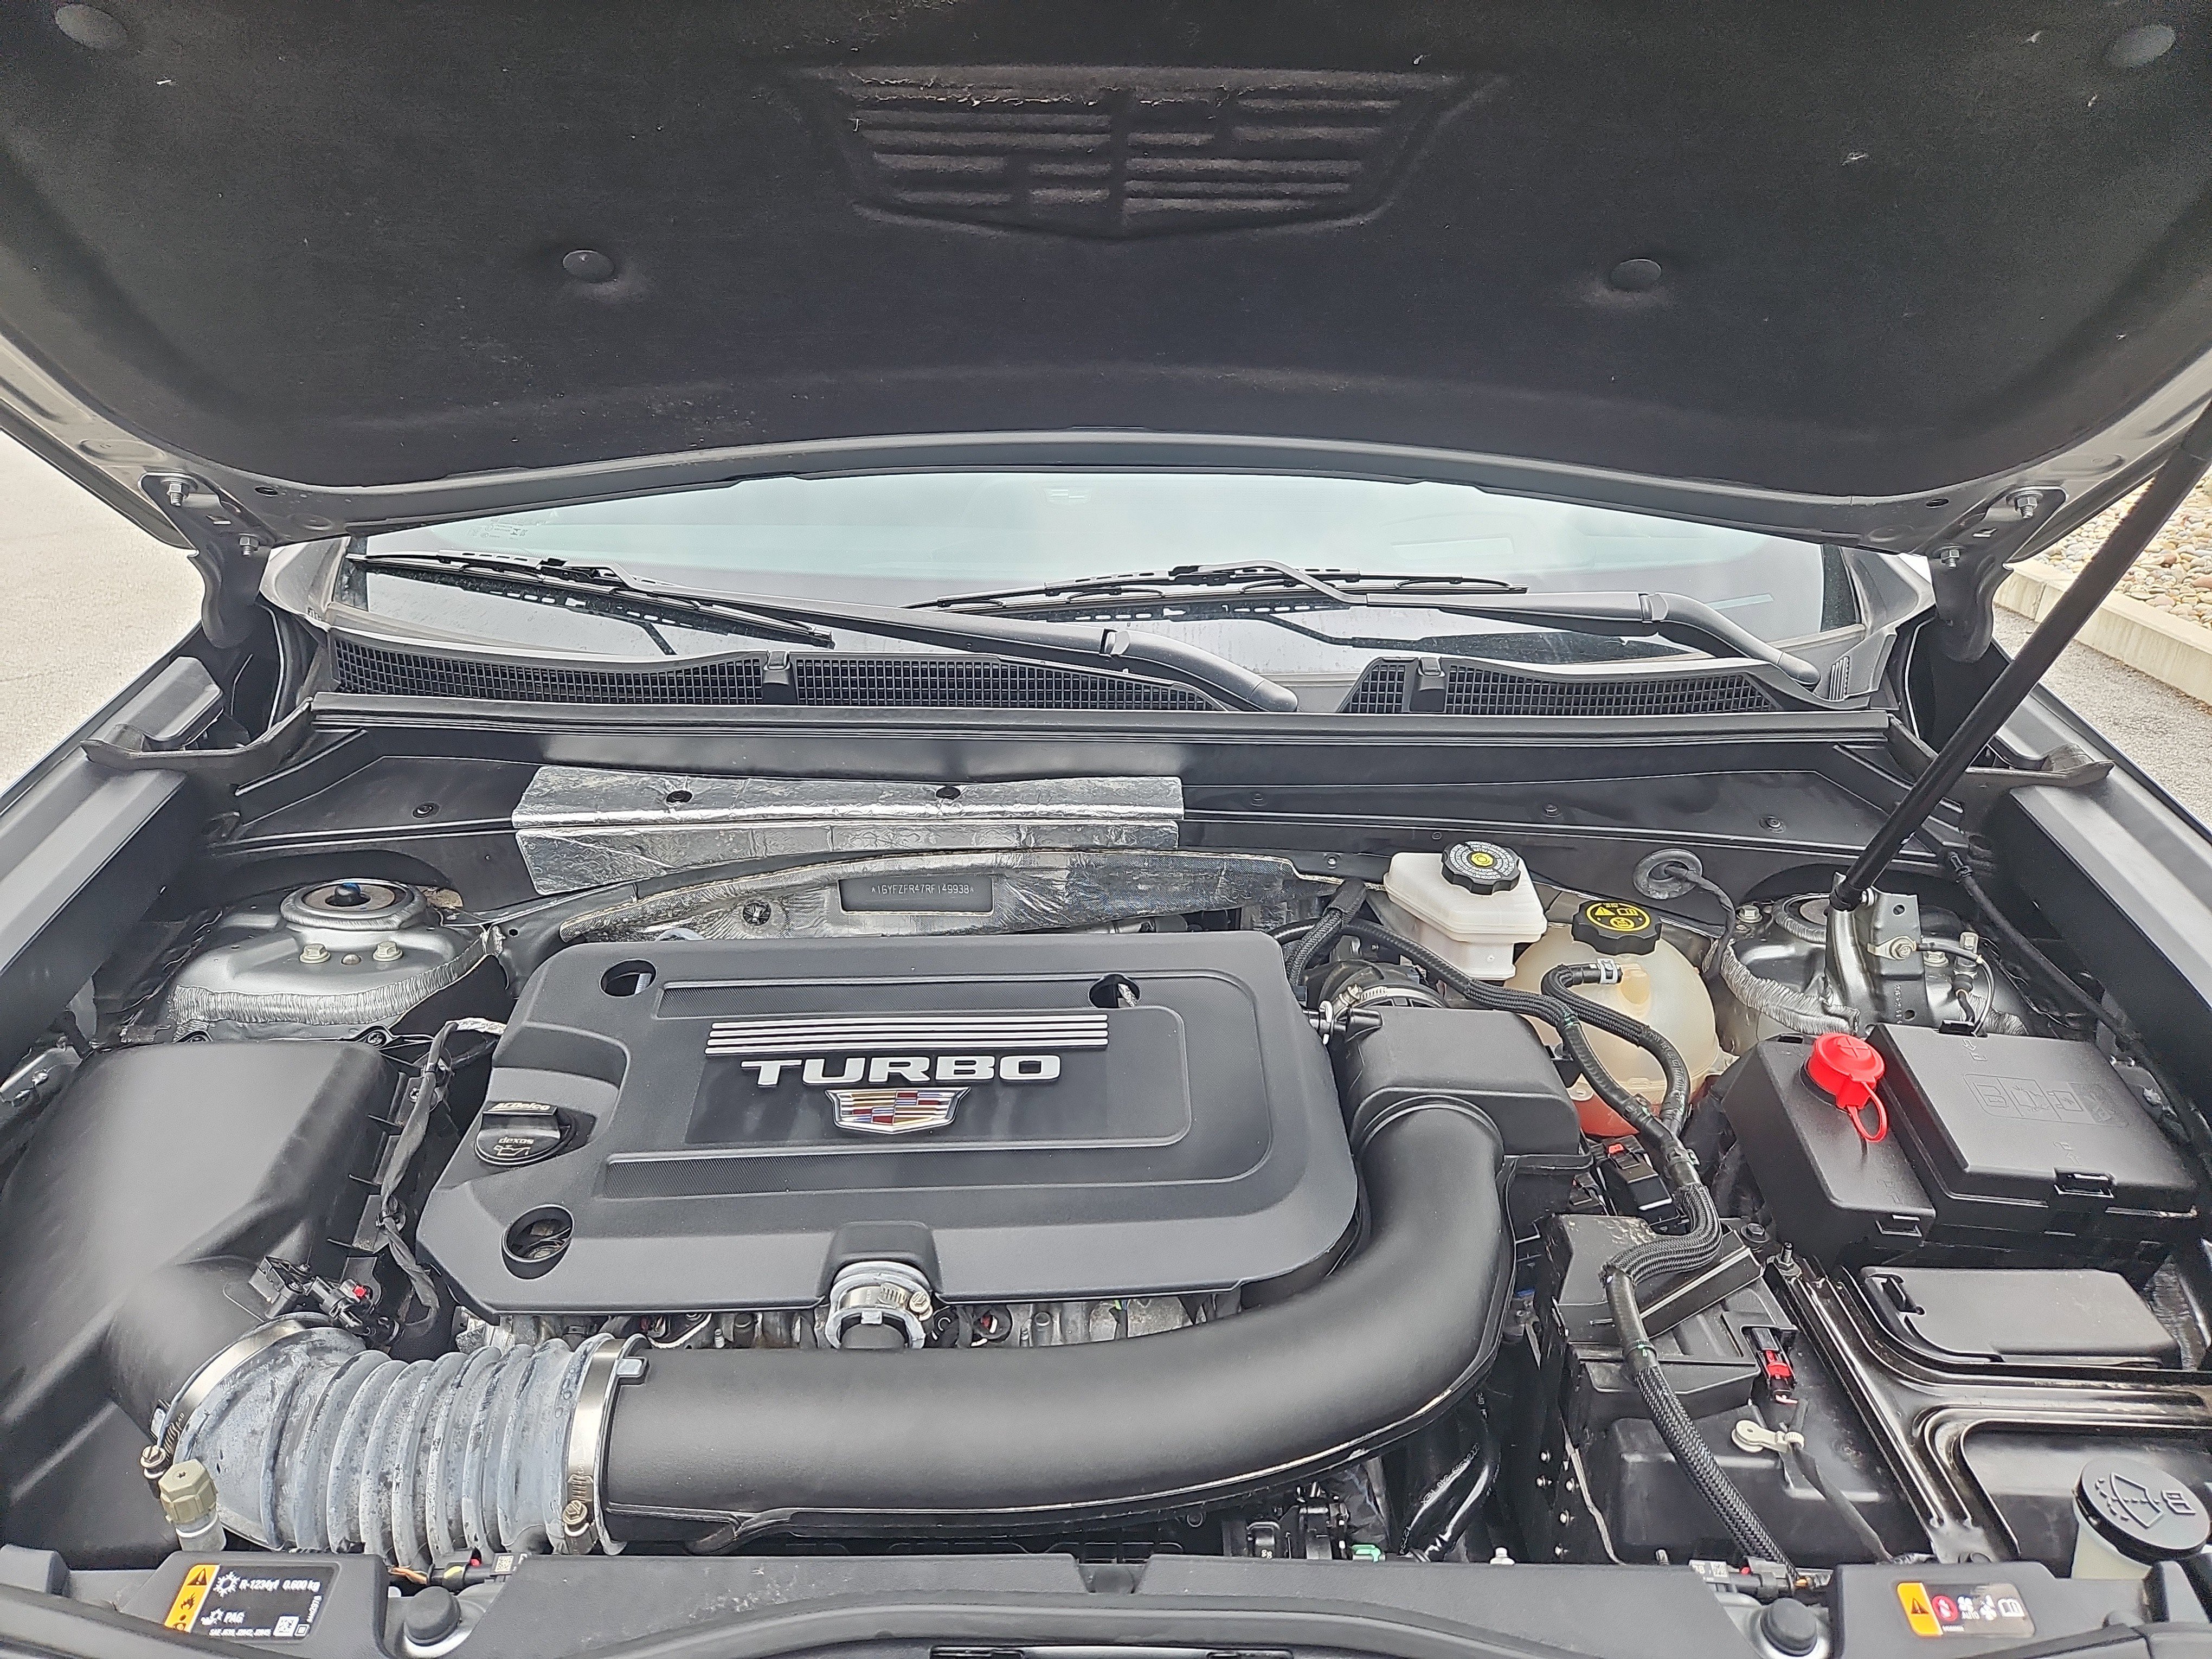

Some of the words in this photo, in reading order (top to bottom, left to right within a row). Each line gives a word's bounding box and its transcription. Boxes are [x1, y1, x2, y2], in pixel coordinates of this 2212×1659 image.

[741, 1055, 1060, 1085] TURBO
[491, 1102, 551, 1111] ACDelco
[498, 1136, 535, 1144] dexos
[282, 1579, 307, 1591] 0.600
[307, 1579, 321, 1592] kg
[223, 1611, 245, 1624] PAG
[1962, 1610, 1980, 1619] AUTO
